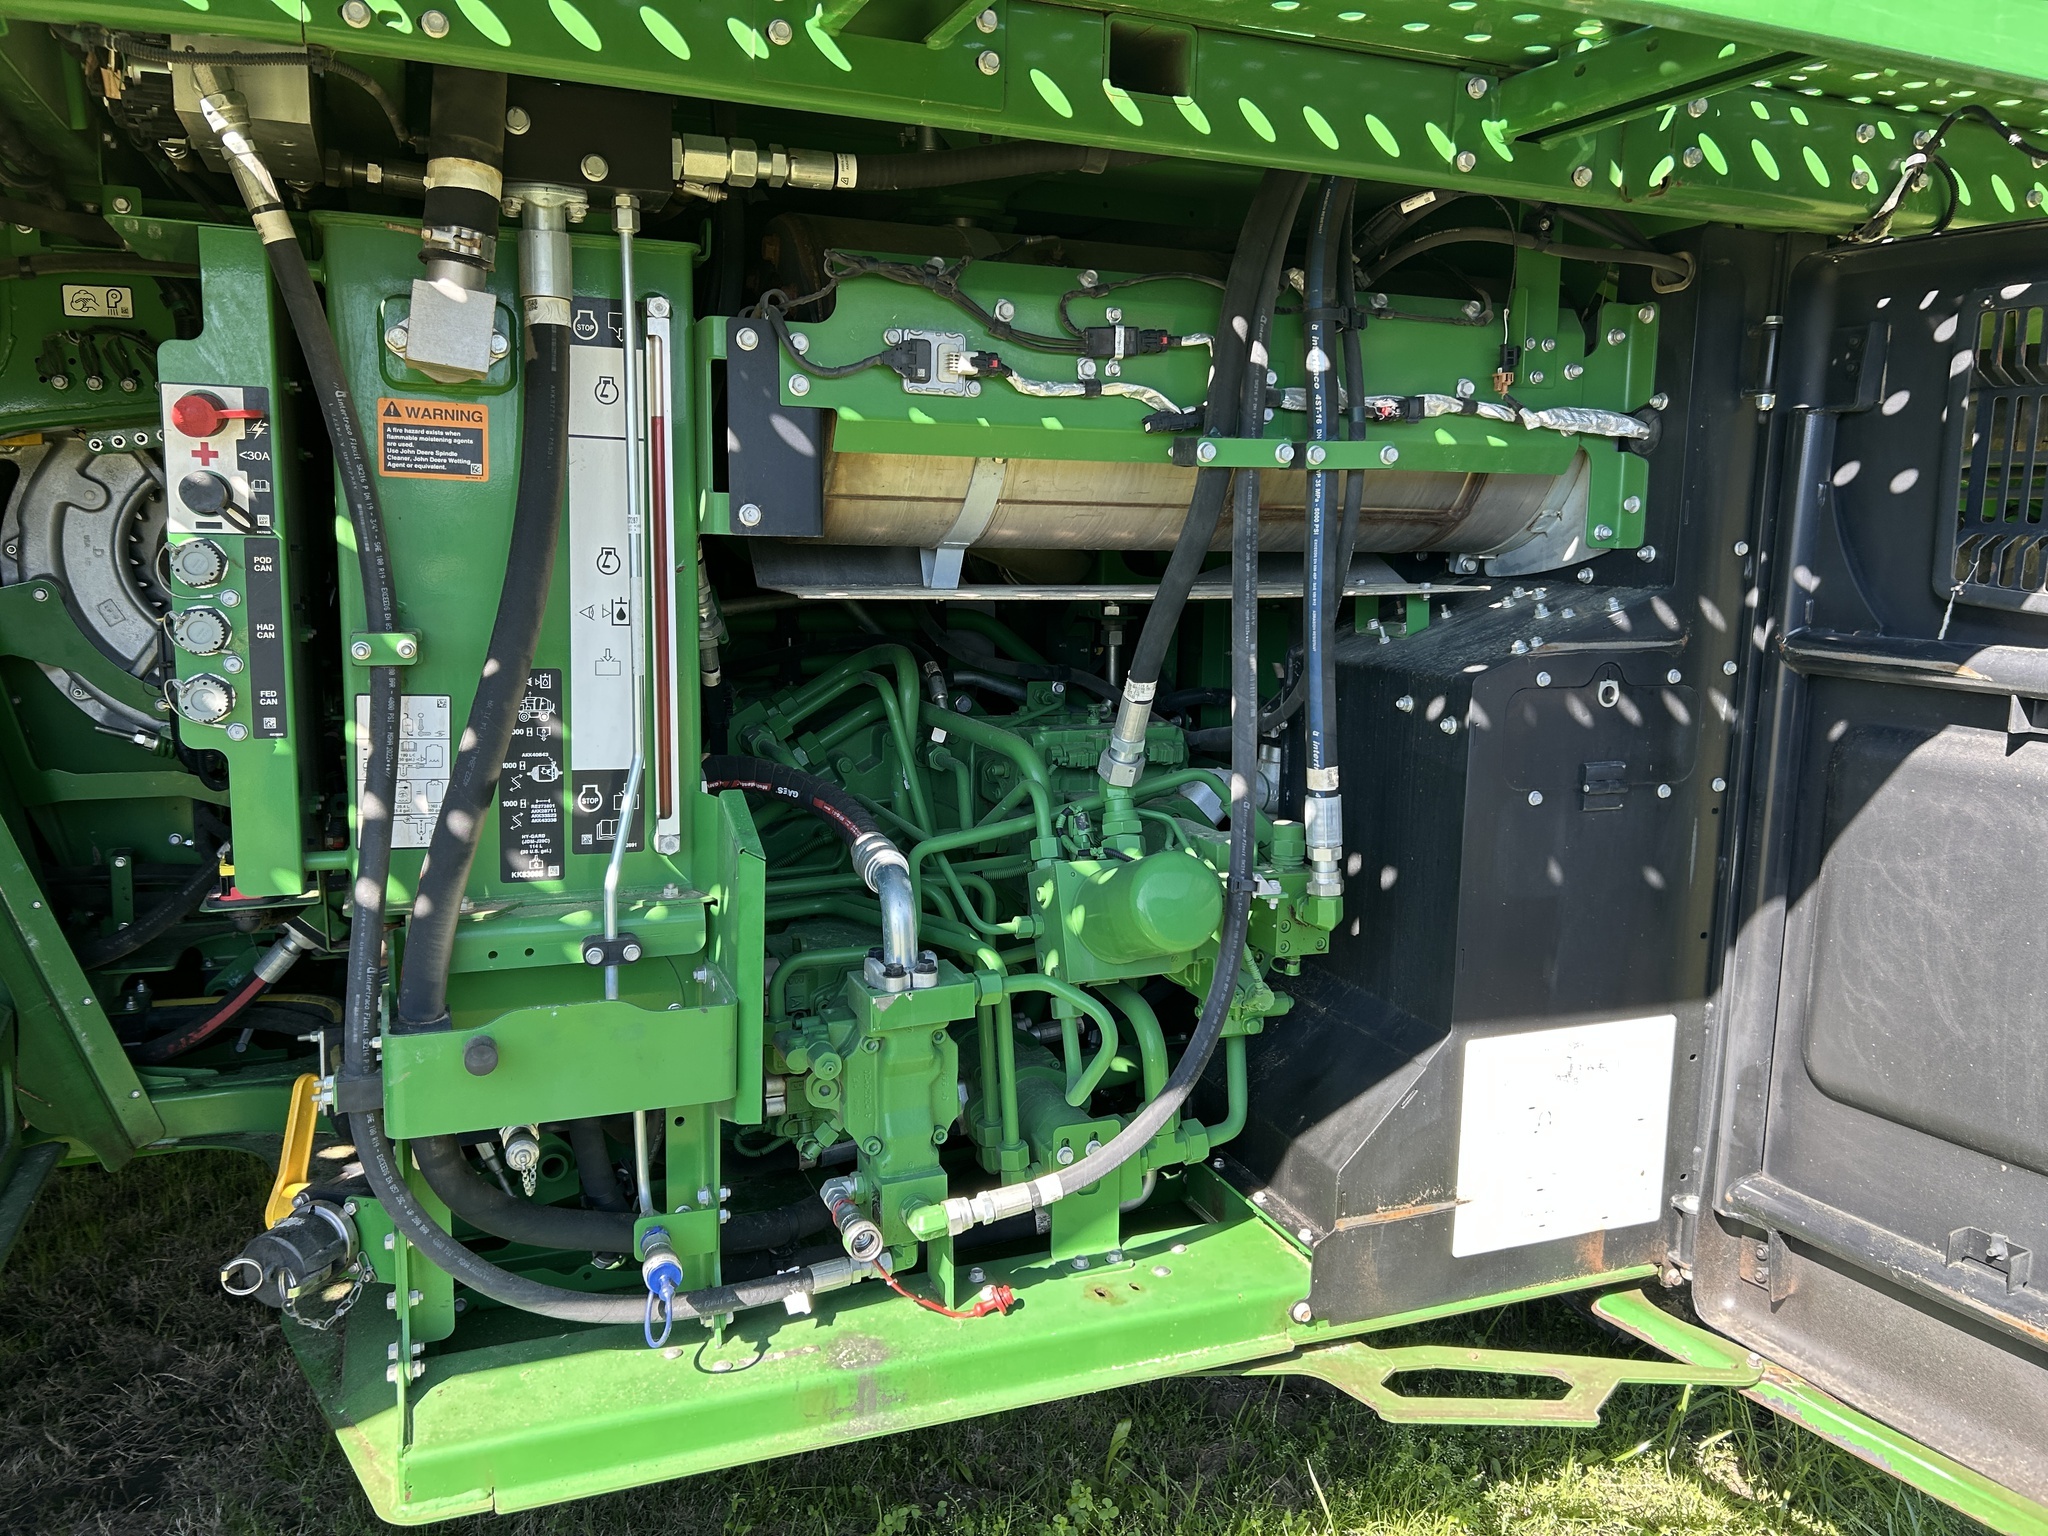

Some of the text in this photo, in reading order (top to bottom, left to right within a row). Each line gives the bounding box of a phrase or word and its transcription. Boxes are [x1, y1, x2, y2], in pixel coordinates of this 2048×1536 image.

[577, 323, 595, 332] STOP
[1315, 394, 1323, 425] 4ST-16
[405, 406, 483, 423] WARNING
[419, 435, 452, 444] moistening
[239, 451, 270, 461] <30A
[435, 450, 458, 458] Spindle
[387, 461, 406, 469] Agent
[414, 463, 447, 471] equivalent.
[448, 457, 471, 466] Wetting
[349, 437, 361, 460] Flexit
[381, 587, 391, 611] EXCEEDS
[256, 623, 275, 631] HAD
[256, 631, 275, 639] CAN
[259, 690, 277, 698] FED
[259, 698, 278, 706] CAN
[387, 713, 395, 723] PSI
[581, 797, 599, 805] STOP
[362, 1012, 371, 1034] Flexit
